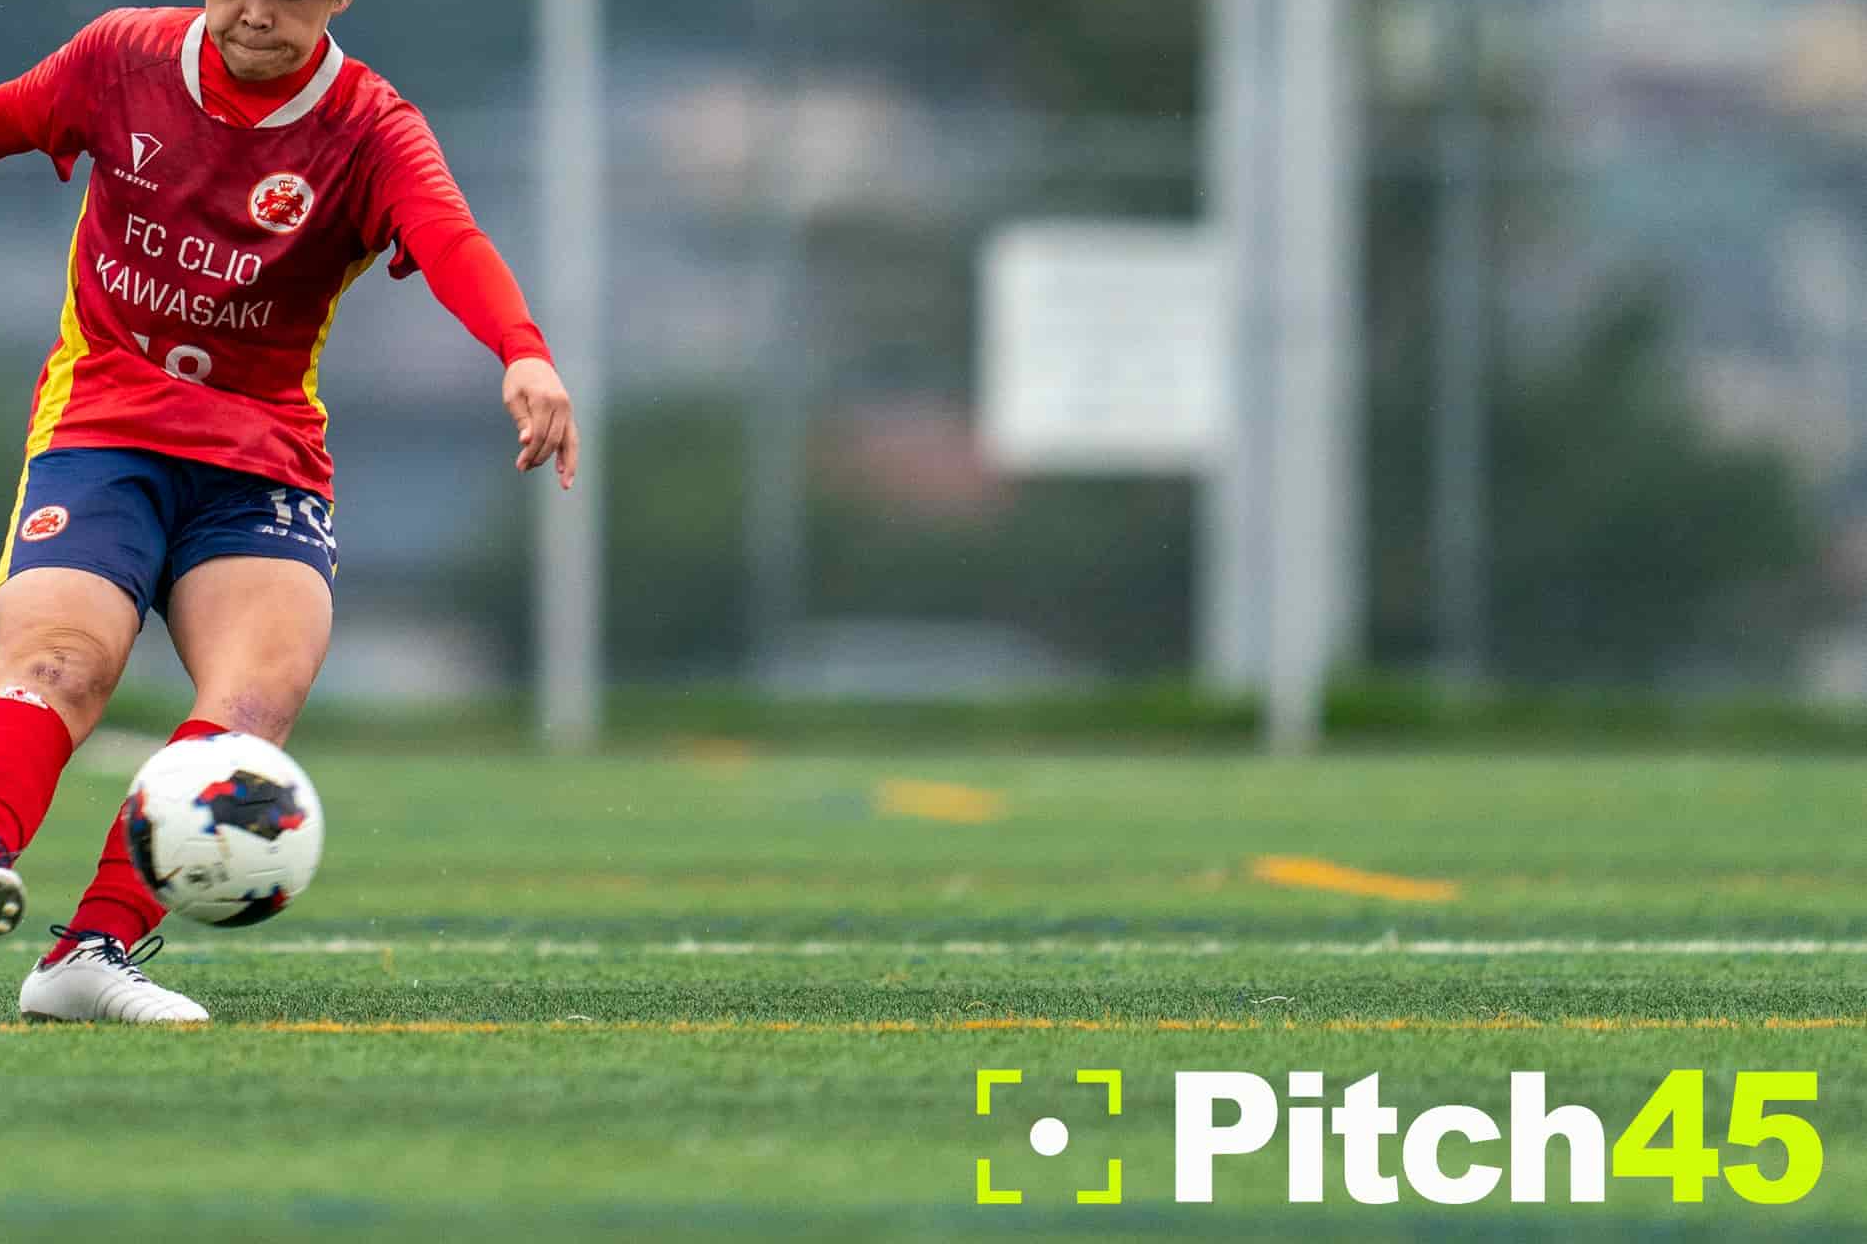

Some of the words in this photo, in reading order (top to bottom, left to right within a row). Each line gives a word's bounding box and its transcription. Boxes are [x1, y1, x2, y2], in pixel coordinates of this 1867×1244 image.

[124, 212, 167, 257] FC
[177, 235, 263, 286] CLIO
[95, 252, 274, 330] KAWASAKI
